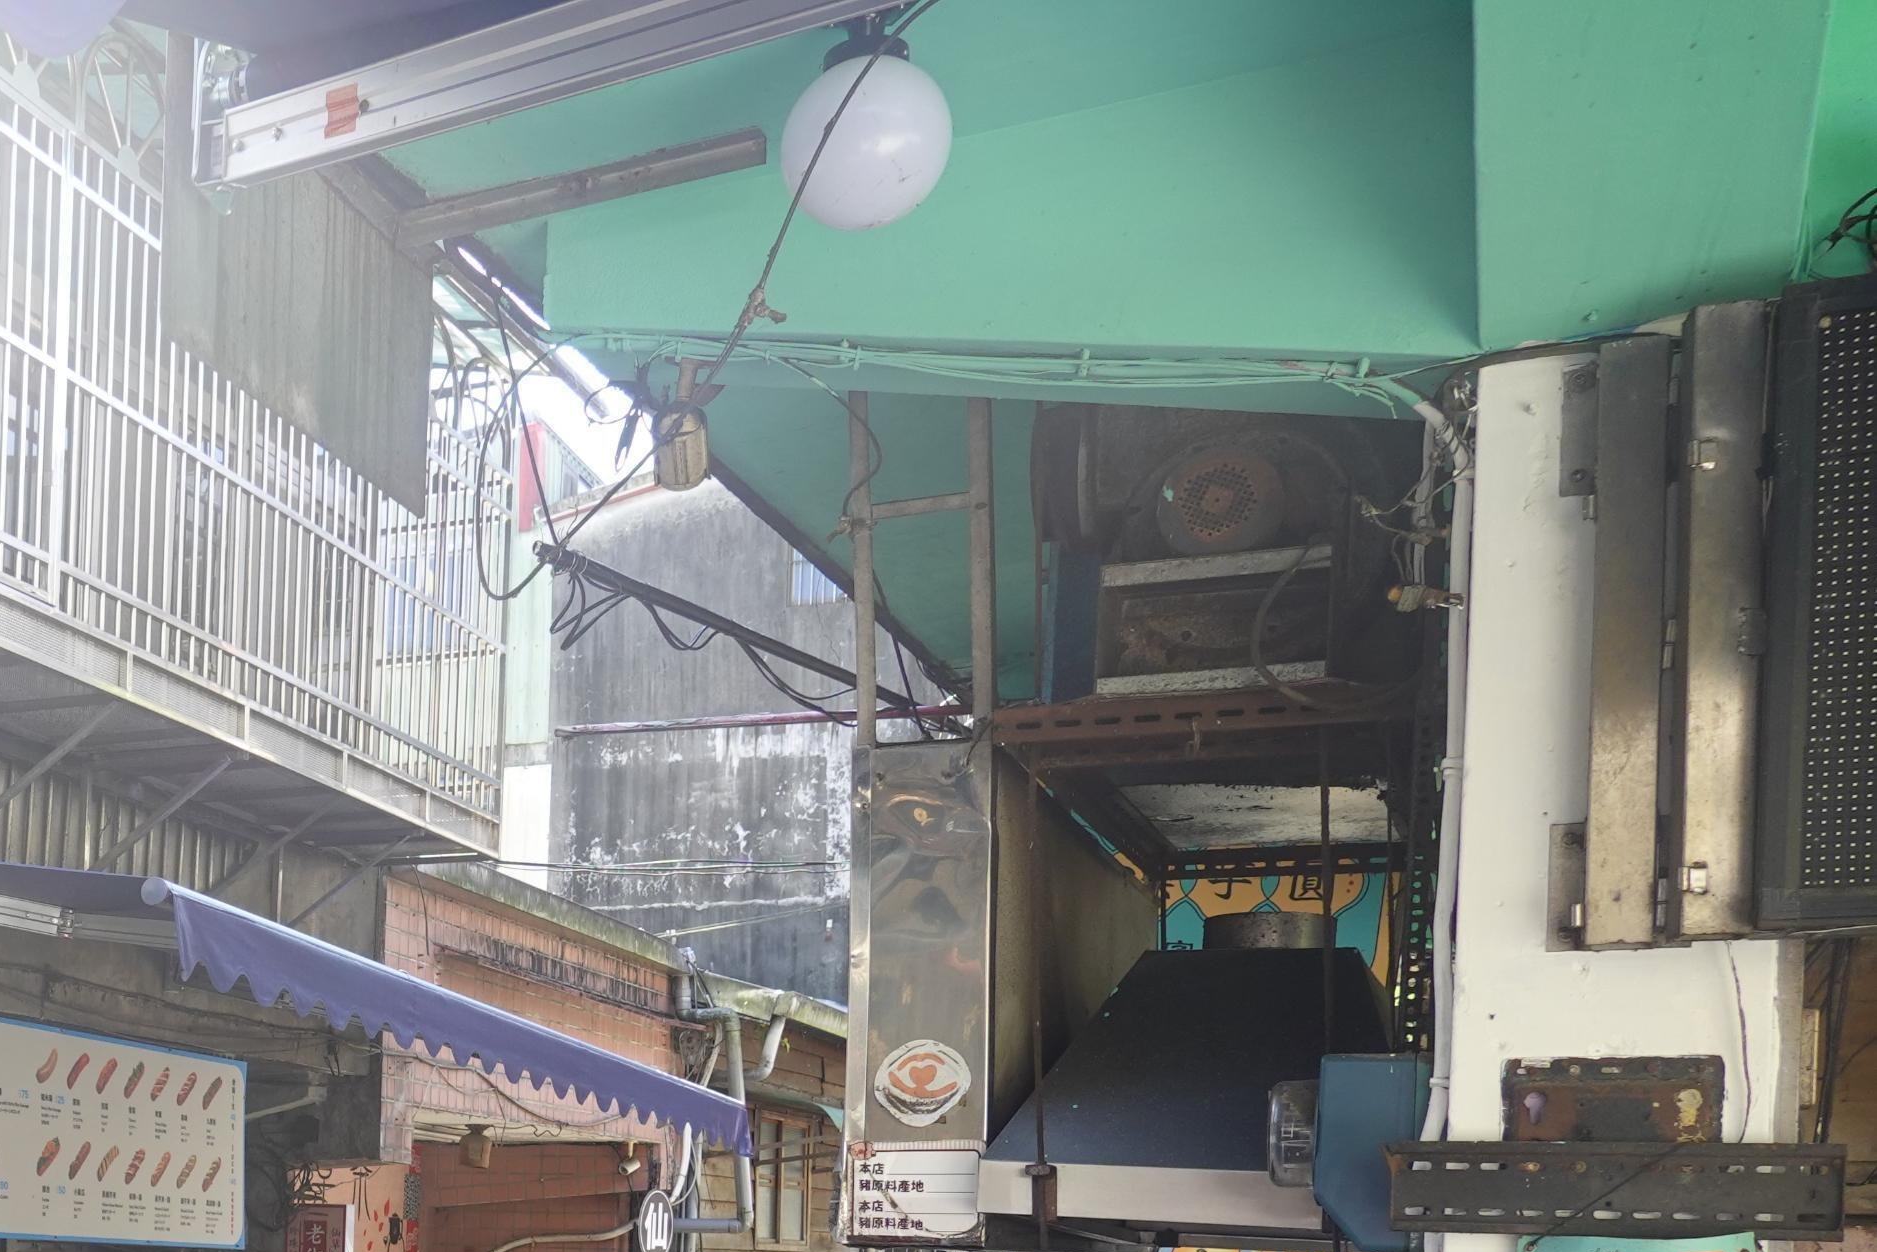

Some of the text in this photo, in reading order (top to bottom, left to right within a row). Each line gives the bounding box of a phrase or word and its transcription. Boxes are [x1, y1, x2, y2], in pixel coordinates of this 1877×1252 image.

[859, 1163, 885, 1175] 本店
[859, 1179, 925, 1193] 豬原料產地
[859, 1200, 884, 1213] 本店
[859, 1217, 923, 1231] 豬原料產地
